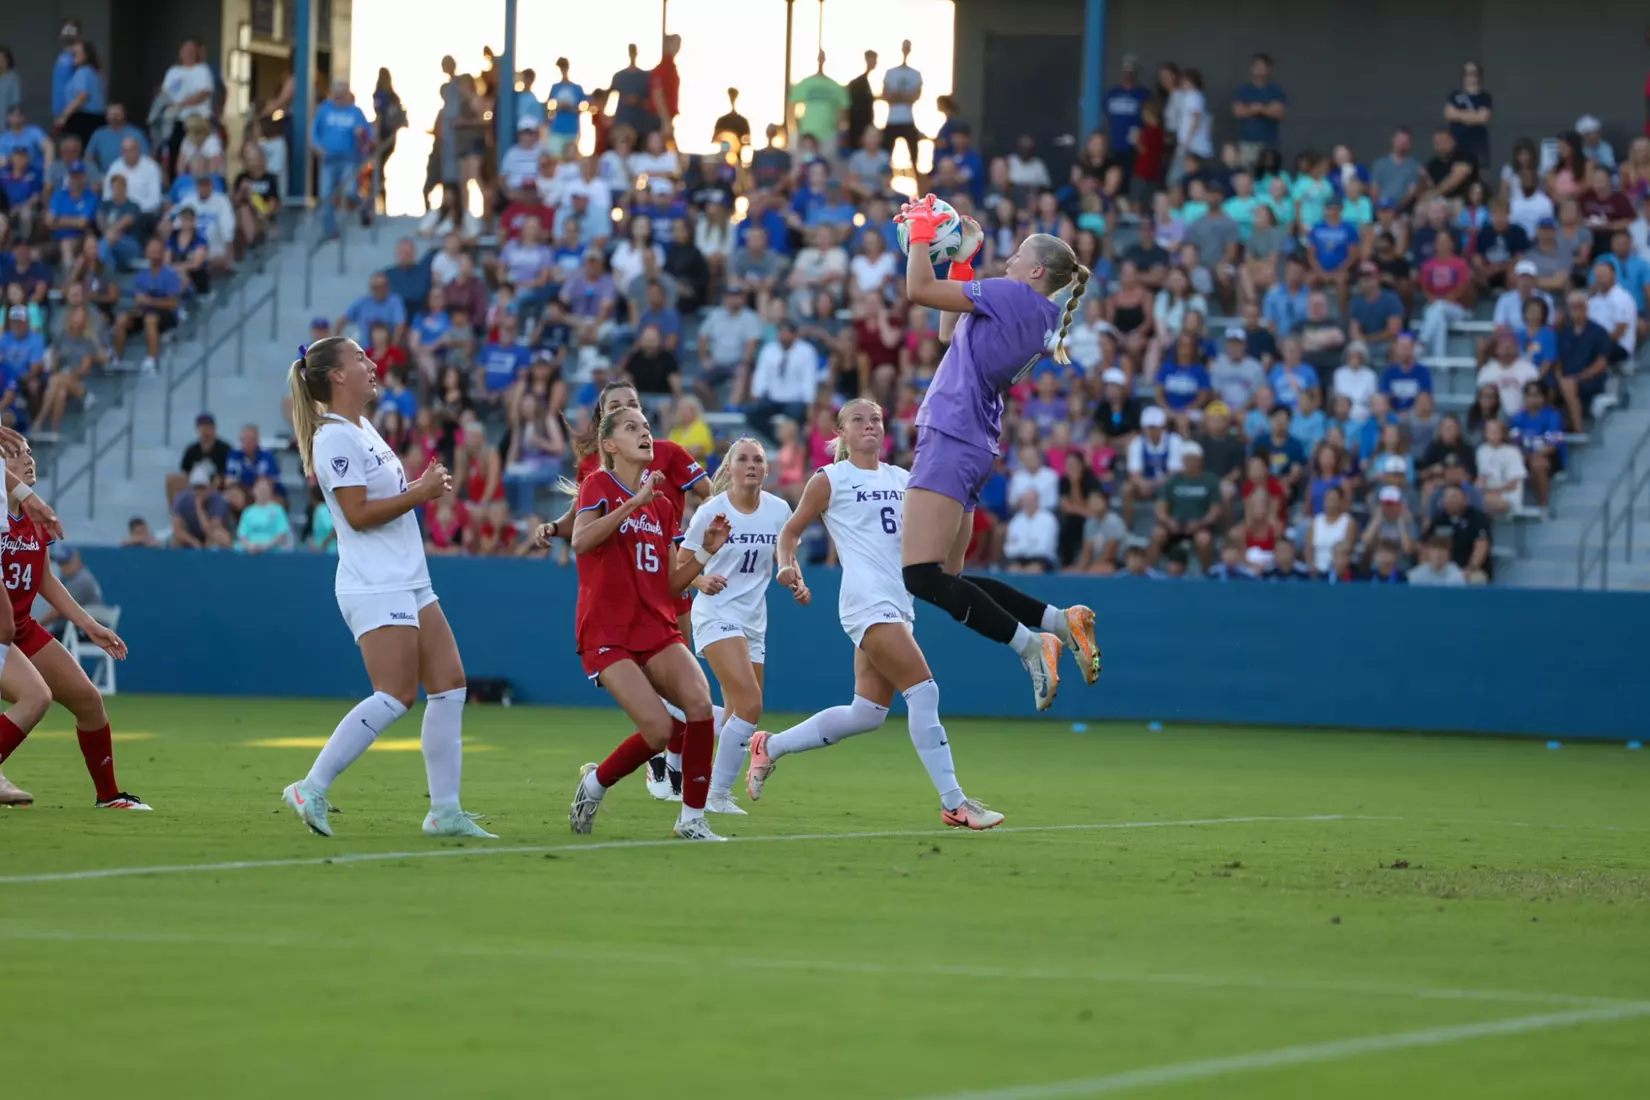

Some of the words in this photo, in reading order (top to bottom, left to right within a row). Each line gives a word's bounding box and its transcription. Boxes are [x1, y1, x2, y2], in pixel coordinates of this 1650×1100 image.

[856, 490, 906, 502] K-STAT
[880, 506, 897, 534] 6
[635, 541, 660, 573] 15
[739, 549, 759, 573] 11
[5, 562, 32, 590] 34
